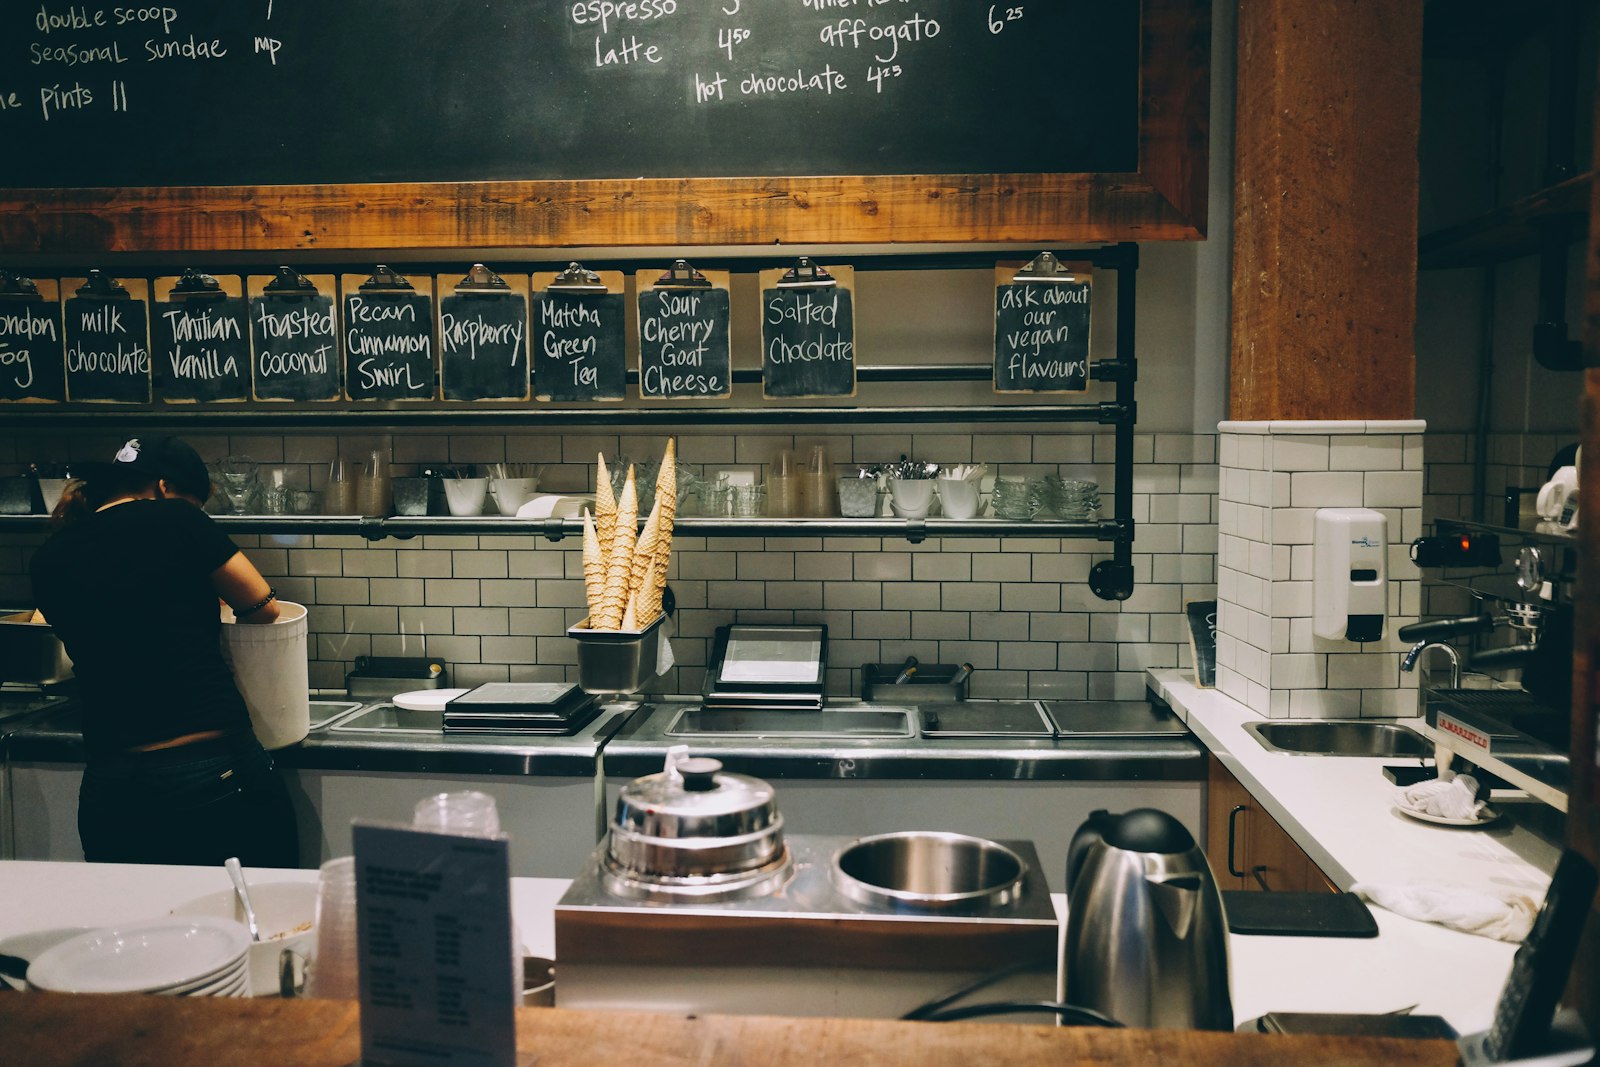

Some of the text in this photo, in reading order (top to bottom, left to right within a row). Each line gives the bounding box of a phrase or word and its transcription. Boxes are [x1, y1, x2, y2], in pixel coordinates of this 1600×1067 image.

[114, 7, 177, 34] scoop
[572, 0, 676, 33] espresso
[820, 12, 940, 62] affogato
[41, 82, 92, 120] pints
[696, 72, 727, 103] hot
[350, 297, 415, 323] Pecan
[659, 292, 700, 317] Sour
[769, 294, 837, 328] Salted
[1002, 285, 1088, 309] ask about
[82, 305, 126, 333] milk
[163, 308, 240, 343] Tahitian
[258, 302, 336, 337] toasted
[542, 300, 600, 328] Matcha
[1024, 311, 1056, 325] our
[349, 328, 430, 359] Cinnamon
[441, 314, 522, 367] Raspberry
[544, 331, 596, 359] Green
[644, 317, 714, 344] Cherry
[1008, 326, 1068, 358] vegan
[169, 345, 238, 379] Vanilla
[260, 344, 332, 376] coconut
[661, 341, 709, 366] Goat
[770, 333, 852, 363] Chocolate
[569, 356, 597, 389] Tea
[645, 366, 722, 393] Cheese
[1008, 352, 1085, 379] flavours
